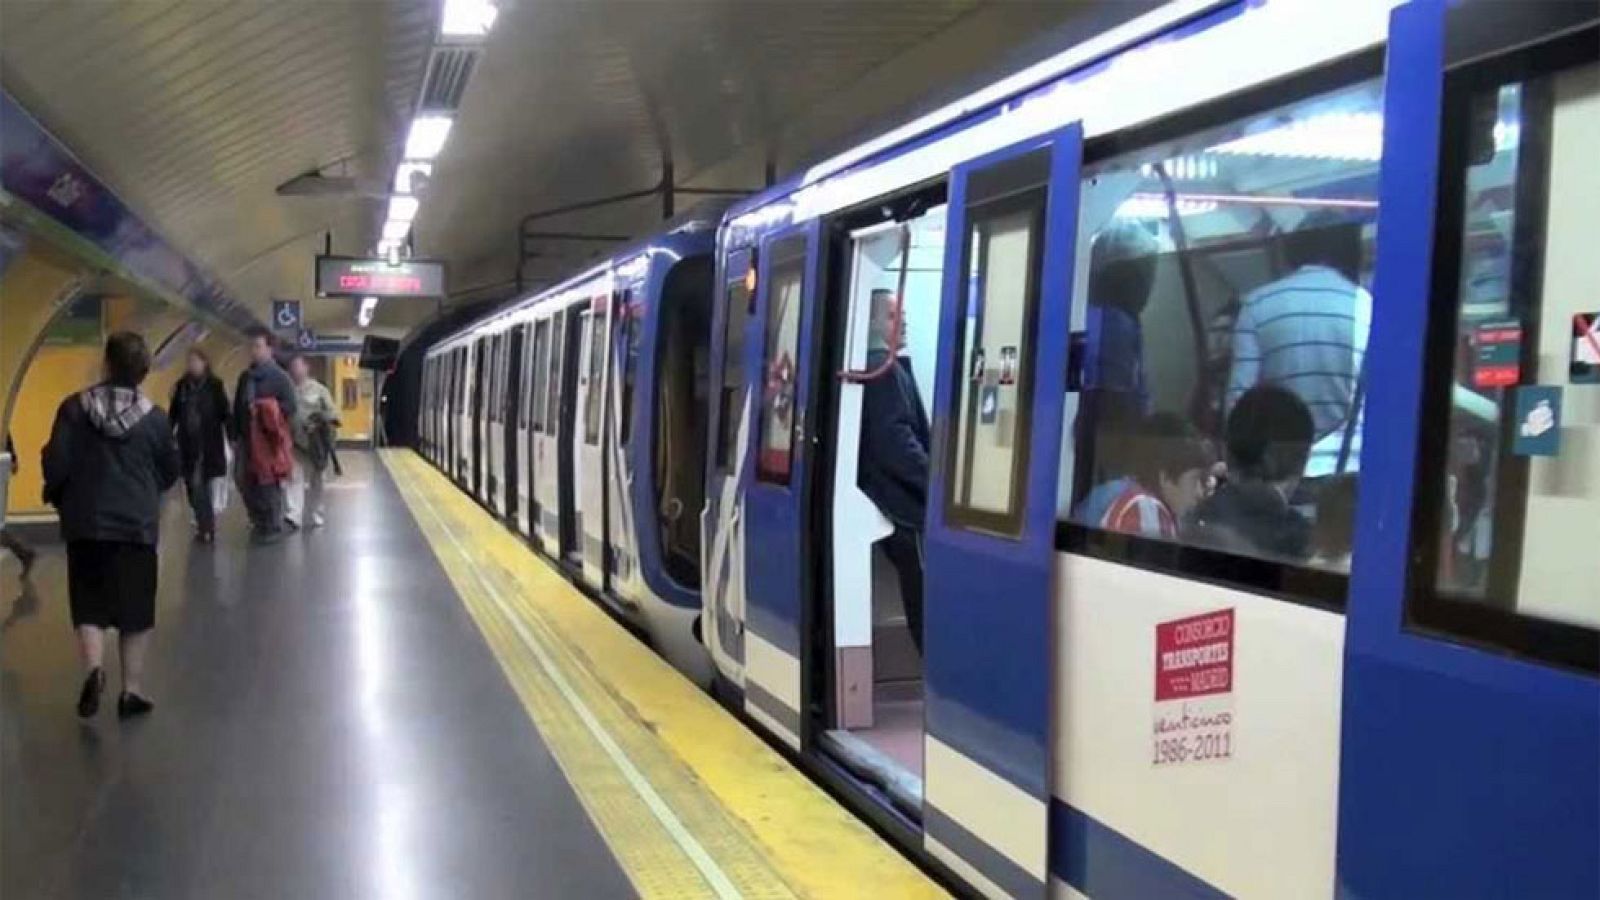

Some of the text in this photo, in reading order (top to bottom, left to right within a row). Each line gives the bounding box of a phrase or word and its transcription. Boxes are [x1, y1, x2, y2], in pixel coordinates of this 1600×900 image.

[1174, 615, 1230, 645] CONSORCIO
[1161, 642, 1229, 671] TRANSPORTES
[1190, 667, 1229, 692] MADRID
[1153, 733, 1231, 765] 1986-2011
